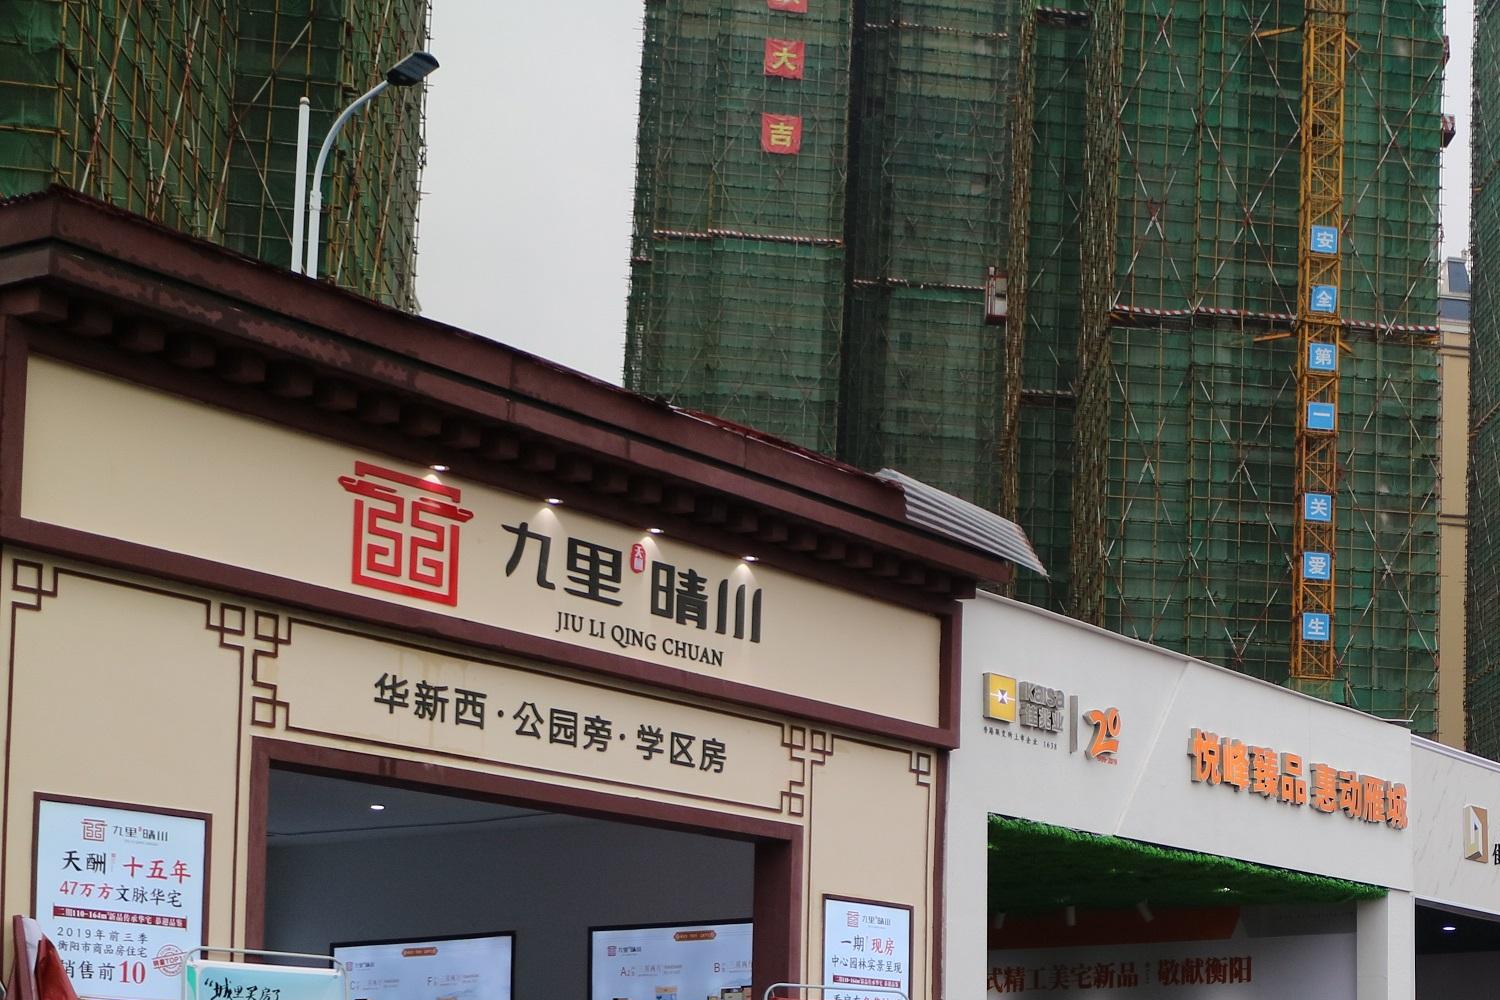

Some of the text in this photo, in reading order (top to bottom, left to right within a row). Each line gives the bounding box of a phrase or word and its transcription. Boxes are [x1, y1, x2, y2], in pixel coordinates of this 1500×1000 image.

[502, 521, 763, 644] 九里晴川
[556, 611, 724, 667] JIU LI QING CHUAN
[1019, 681, 1065, 710] Kaisa
[1020, 701, 1065, 734] 佳兆业
[1310, 762, 1409, 829] 惠动雁城
[122, 855, 191, 885] 十五年
[59, 880, 183, 908] 47万方文脉华宅
[56, 926, 149, 945] 2019年前三季
[57, 940, 148, 959] 衡阳市商品房住宅
[871, 938, 895, 956] 现房
